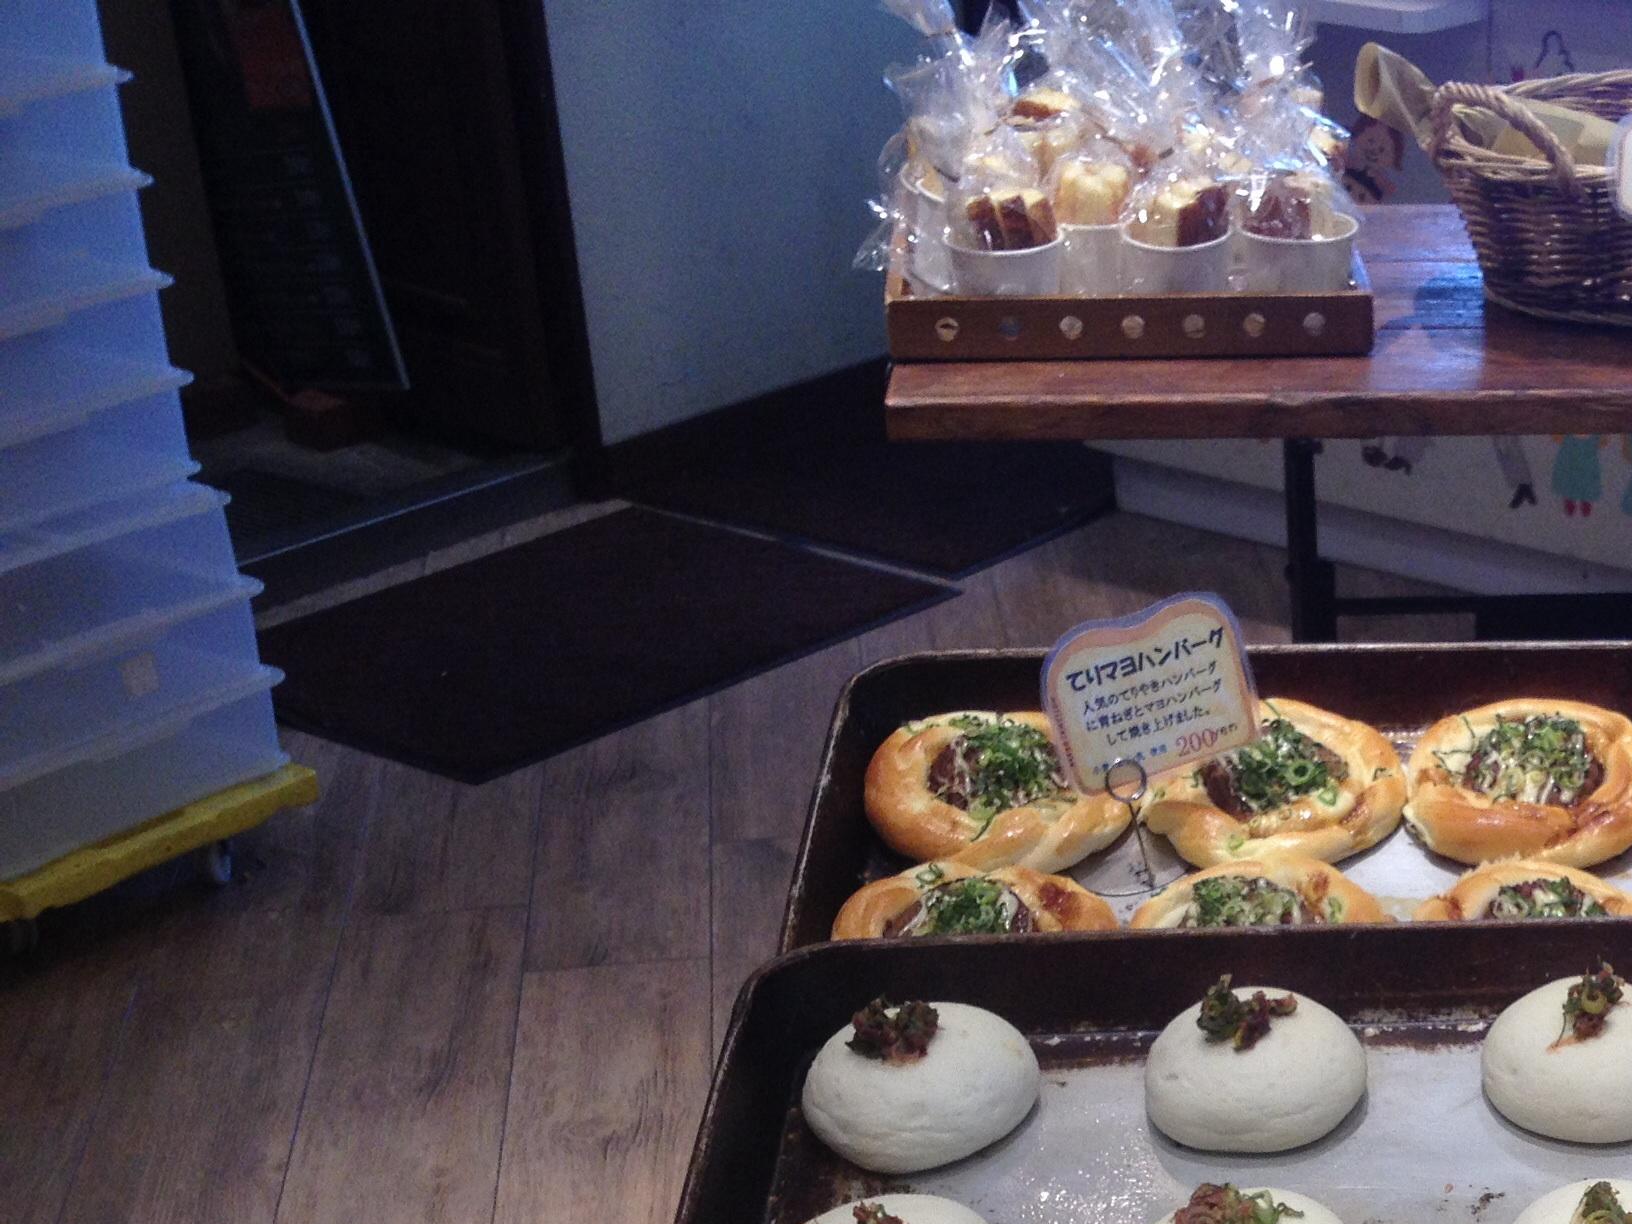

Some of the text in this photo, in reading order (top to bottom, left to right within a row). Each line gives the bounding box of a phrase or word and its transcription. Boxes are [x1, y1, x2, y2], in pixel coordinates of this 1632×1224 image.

[1065, 626, 1224, 692] てりマヨハンバーグ
